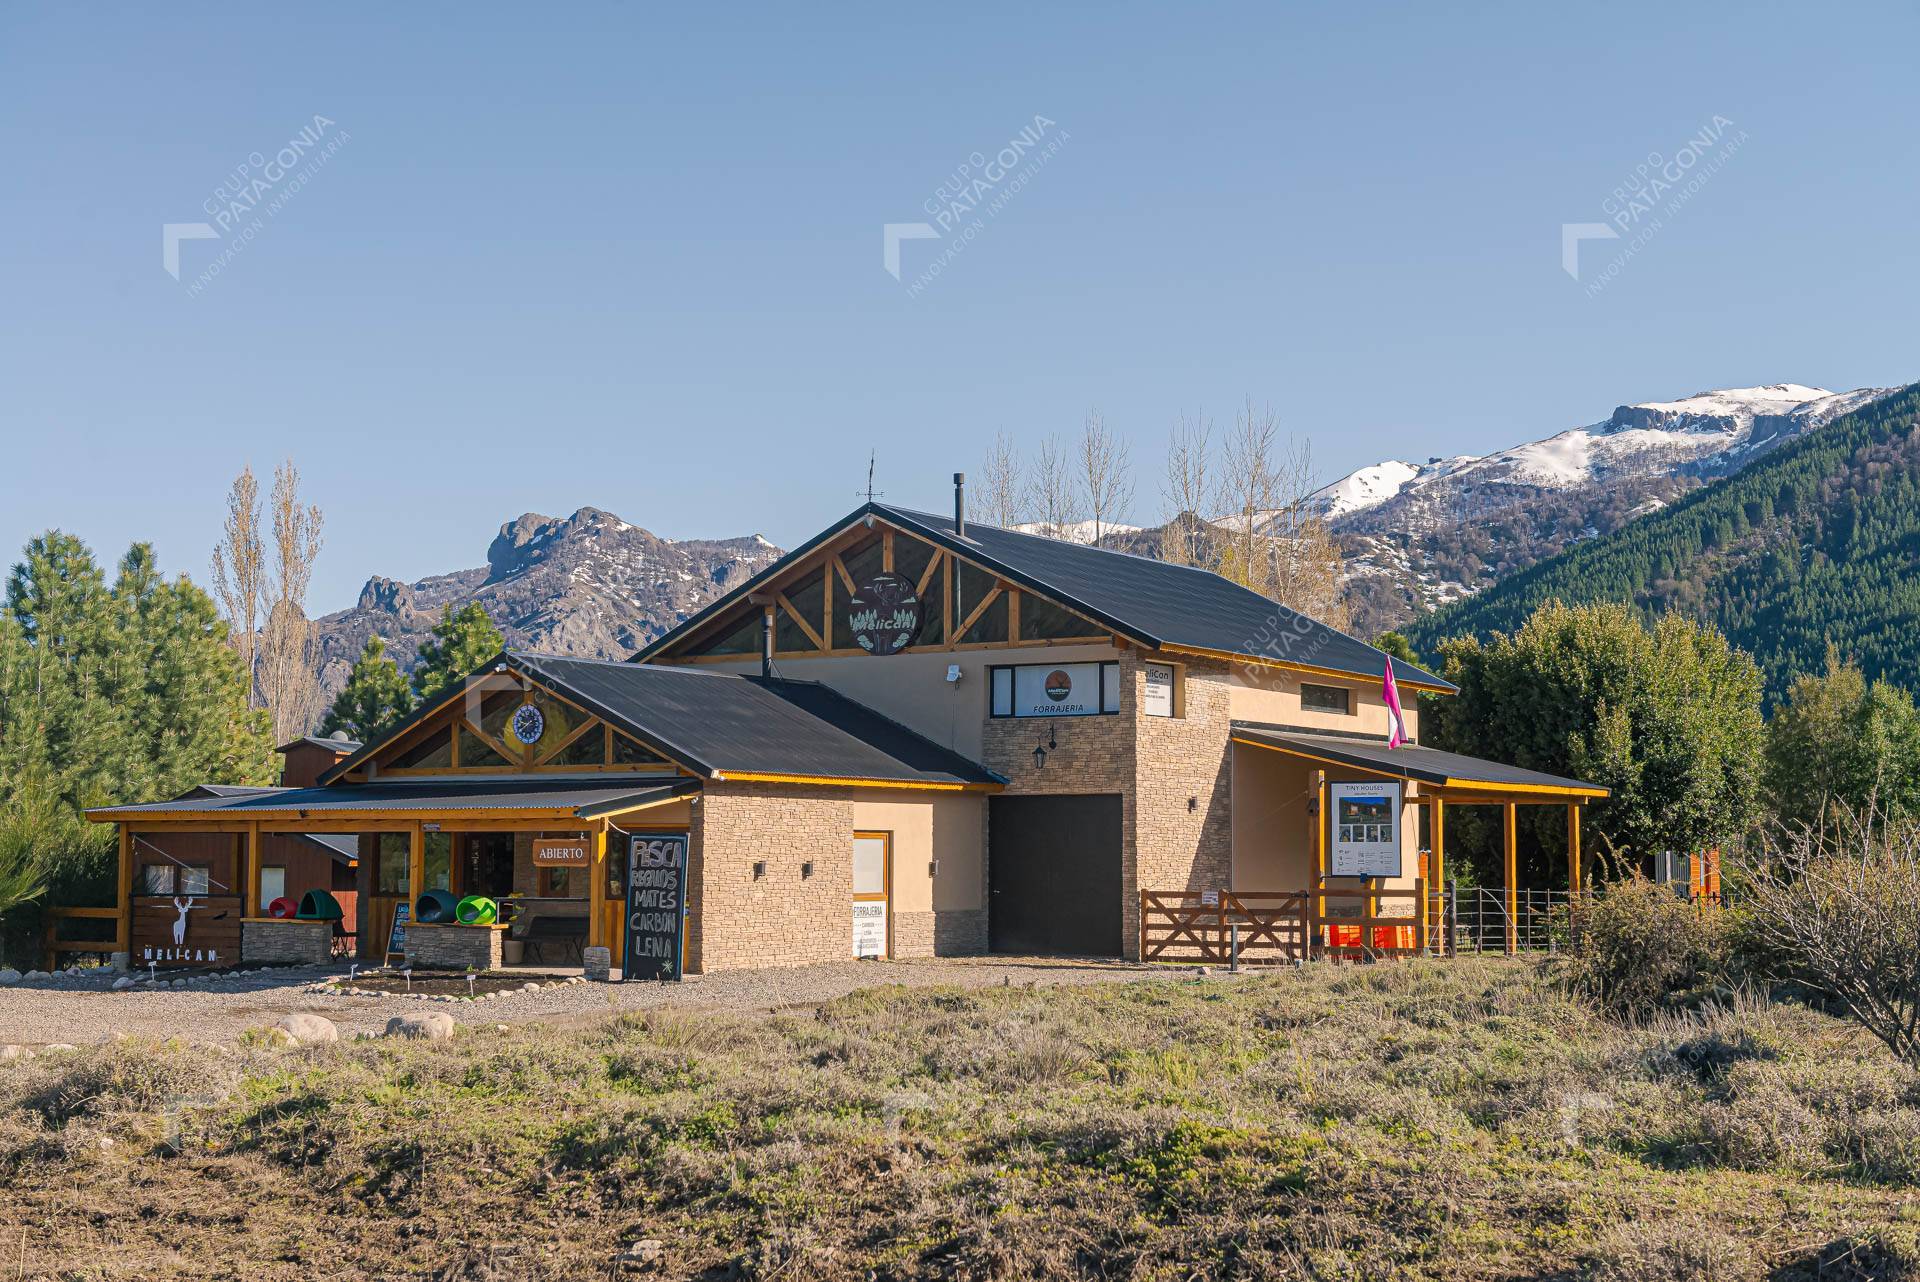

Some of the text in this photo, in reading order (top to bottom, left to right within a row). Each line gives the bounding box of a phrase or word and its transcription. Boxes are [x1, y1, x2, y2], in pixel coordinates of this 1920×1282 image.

[1033, 704, 1084, 713] FORRAJERIA
[539, 847, 583, 859] ABIERTO
[632, 840, 682, 868] PESCA
[635, 889, 677, 909] MATES
[854, 906, 882, 916] FORRAJERIA
[630, 912, 676, 933] CARBON
[144, 947, 217, 962] MELICAN
